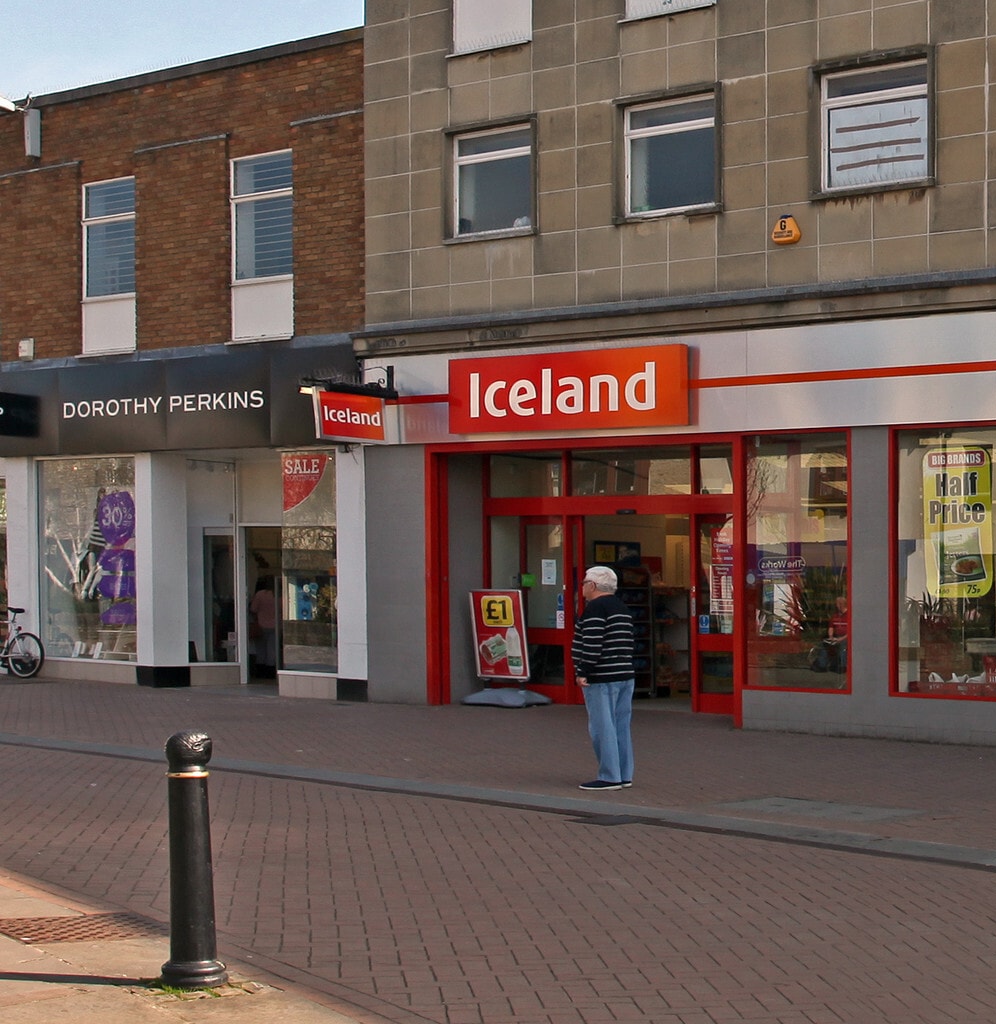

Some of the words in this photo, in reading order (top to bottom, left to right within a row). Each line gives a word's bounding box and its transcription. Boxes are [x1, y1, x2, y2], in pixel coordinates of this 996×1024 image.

[470, 361, 656, 418] Iceland
[63, 396, 162, 419] DOROTHY
[169, 390, 265, 413] PERKINS
[323, 405, 382, 427] Iceland
[284, 459, 320, 475] SALE
[931, 455, 946, 465] BIG
[947, 453, 982, 465] BRANDS
[935, 471, 978, 497] Half
[929, 500, 986, 525] Price
[486, 599, 507, 620] £1
